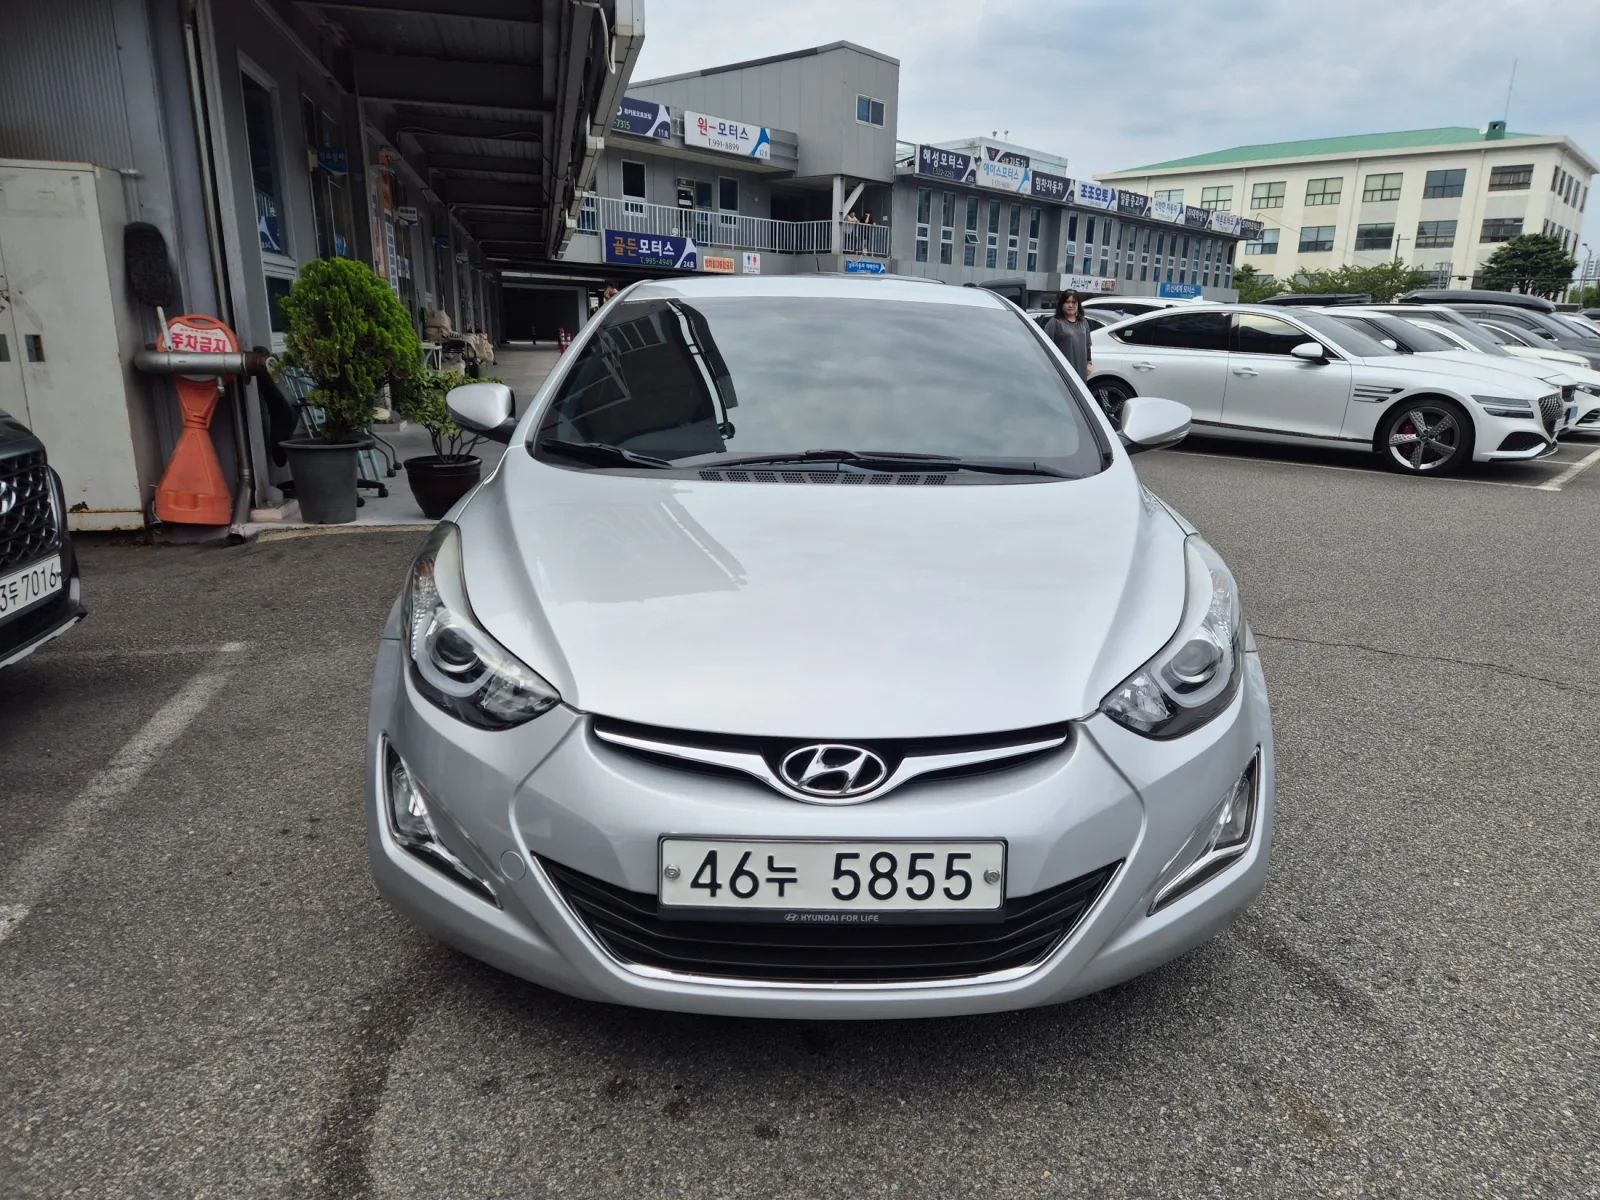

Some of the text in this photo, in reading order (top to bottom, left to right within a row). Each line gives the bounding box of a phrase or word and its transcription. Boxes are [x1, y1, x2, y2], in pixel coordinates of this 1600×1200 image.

[923, 148, 964, 169] 해성모터스
[983, 162, 1019, 181] 에이스모터스
[1036, 176, 1064, 195] 힘찬자동차
[1080, 183, 1109, 202] 조조오토
[613, 236, 675, 257] 골든모터스
[171, 332, 226, 353] 주차금지
[21, 562, 57, 601] 7016
[690, 850, 972, 901] 46누 5855
[801, 914, 879, 922] HYUNDAI FOR LIFE
